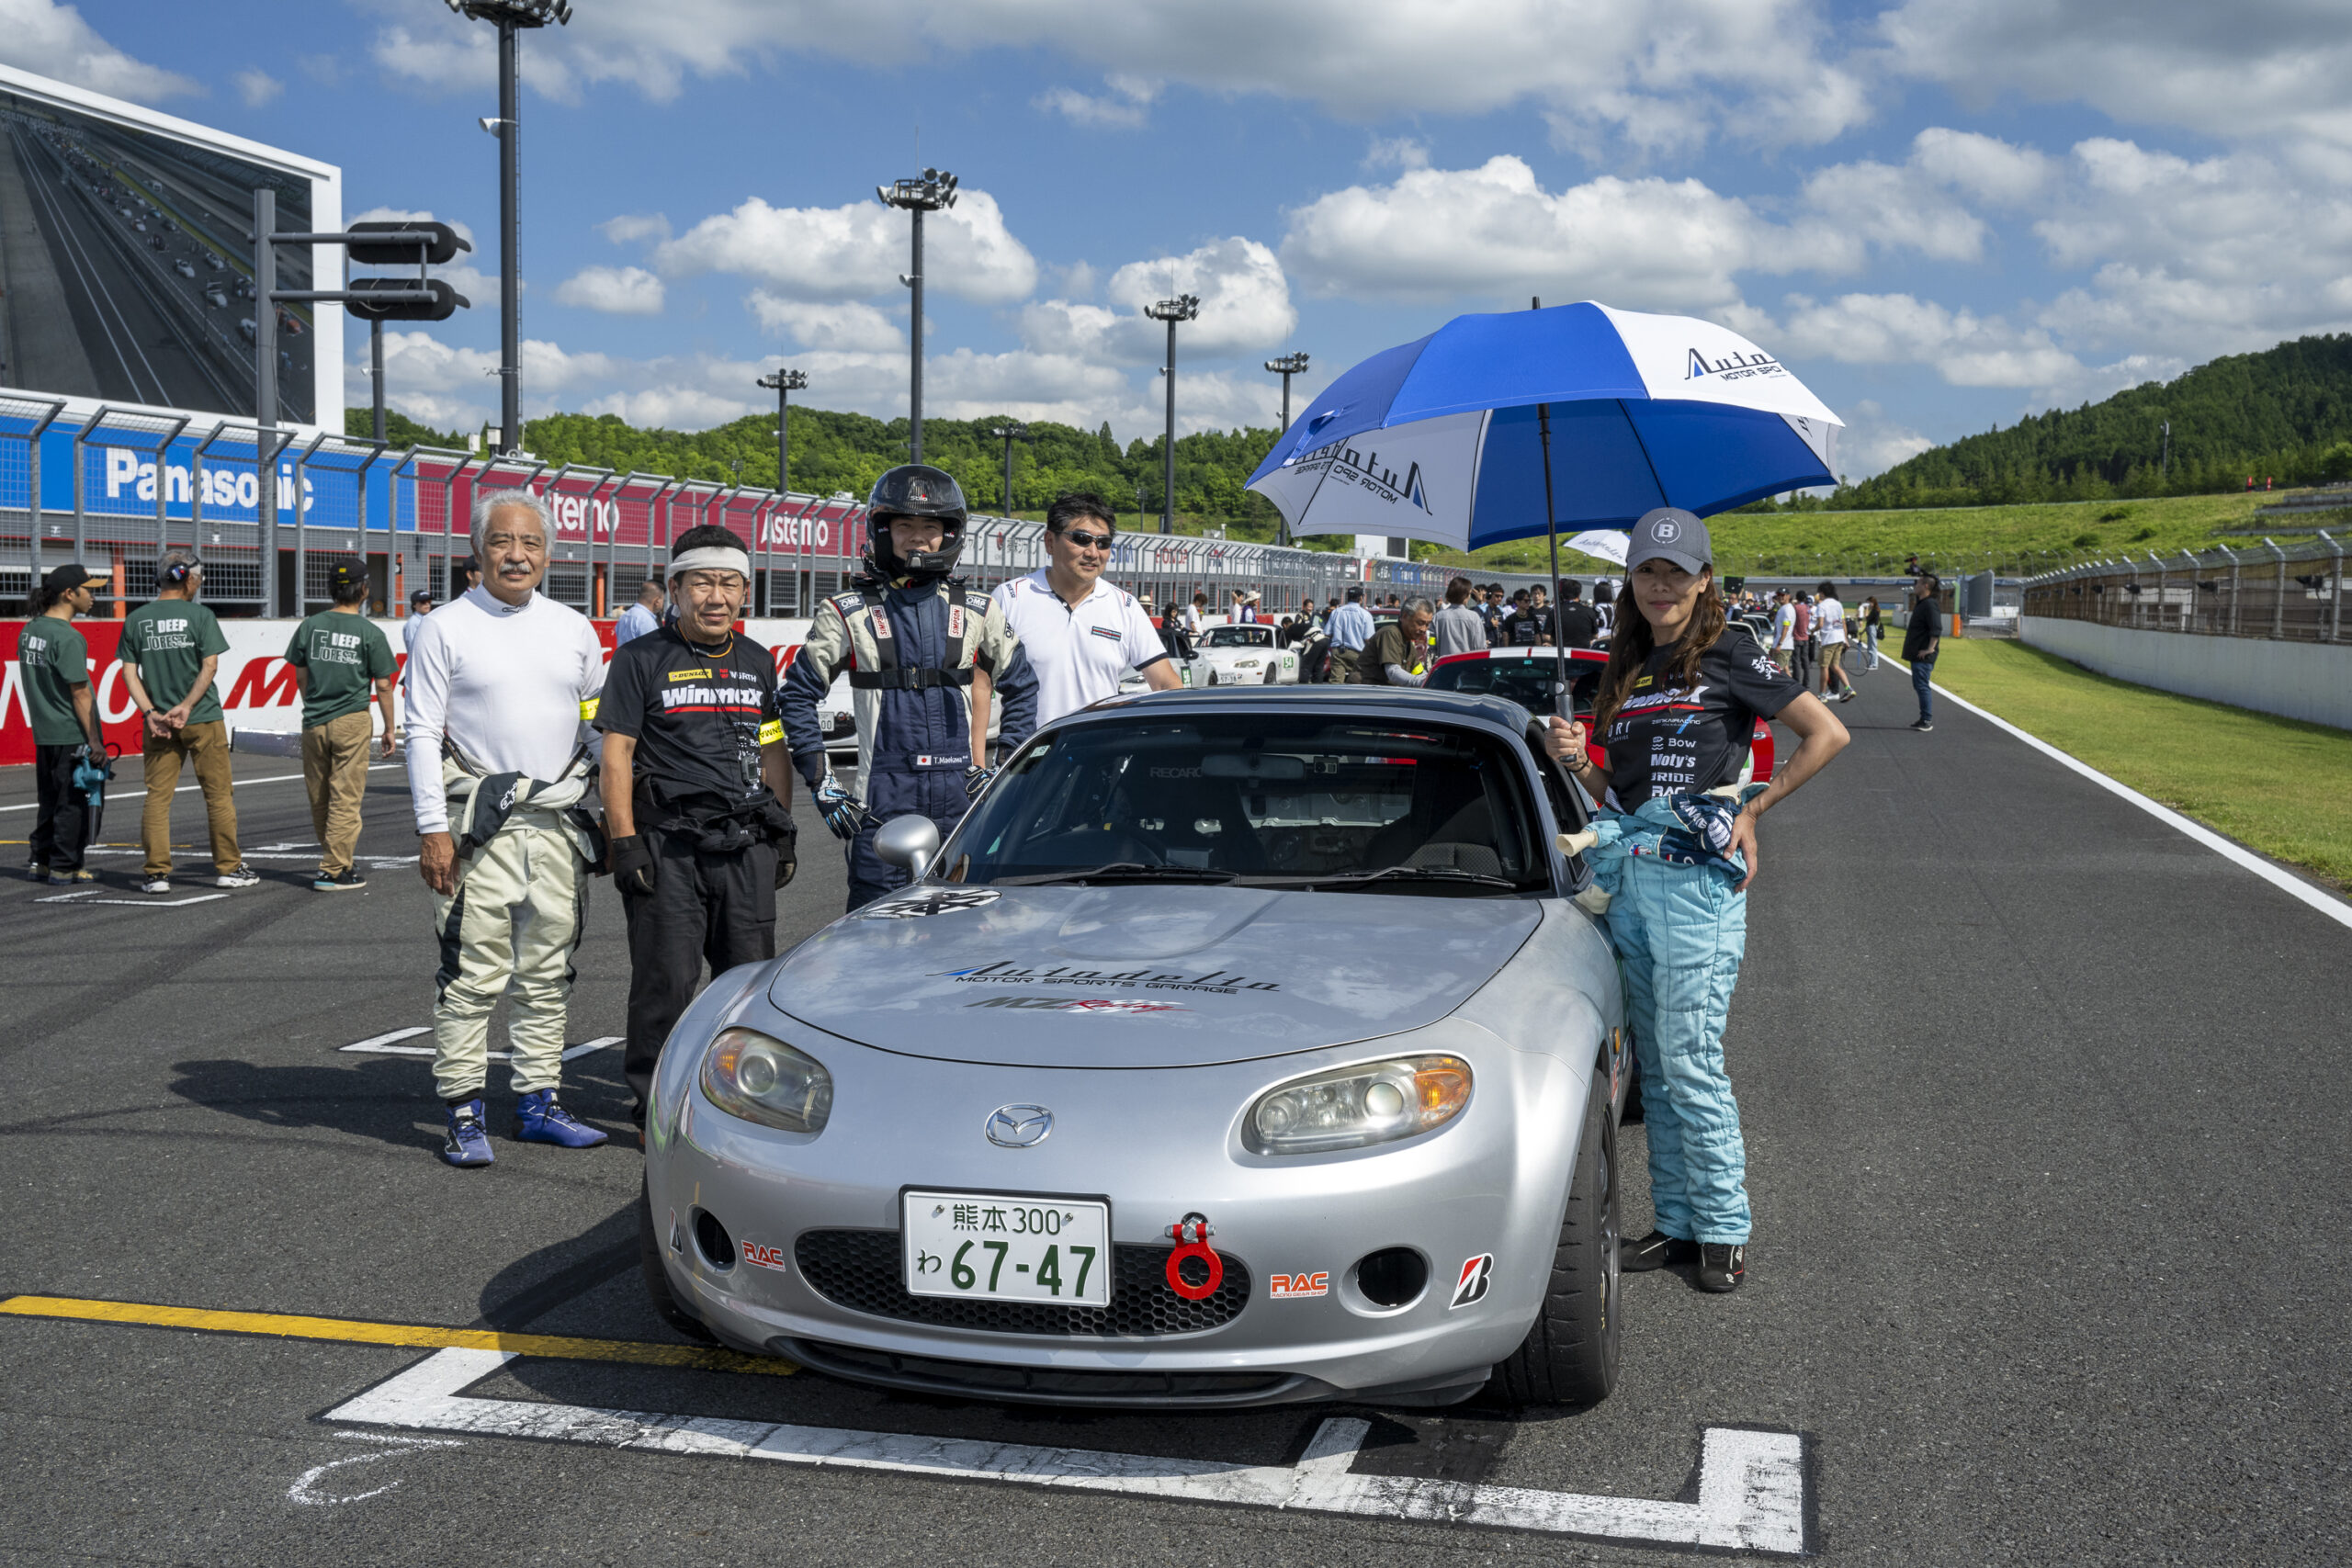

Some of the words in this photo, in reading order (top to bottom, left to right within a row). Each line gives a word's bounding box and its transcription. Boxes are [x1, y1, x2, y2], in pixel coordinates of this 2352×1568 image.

[1720, 369, 1758, 382] MOTOR
[761, 508, 829, 547] Astemo
[841, 597, 860, 608] OMP
[966, 597, 986, 608] OMP
[157, 619, 188, 634] DEEP
[872, 609, 888, 636] SIMPSON
[952, 608, 960, 636] SIMPSON
[332, 632, 361, 649] DEEP
[924, 960, 1282, 992] Autodelta
[955, 975, 1034, 984] MOTOR
[1042, 976, 1137, 988] SPORTS
[1146, 981, 1238, 995] GARAGE
[742, 1241, 784, 1266] RAC
[917, 1248, 943, 1275] わ
[951, 1239, 1096, 1298] 67-47
[1272, 1273, 1329, 1292] RAC
